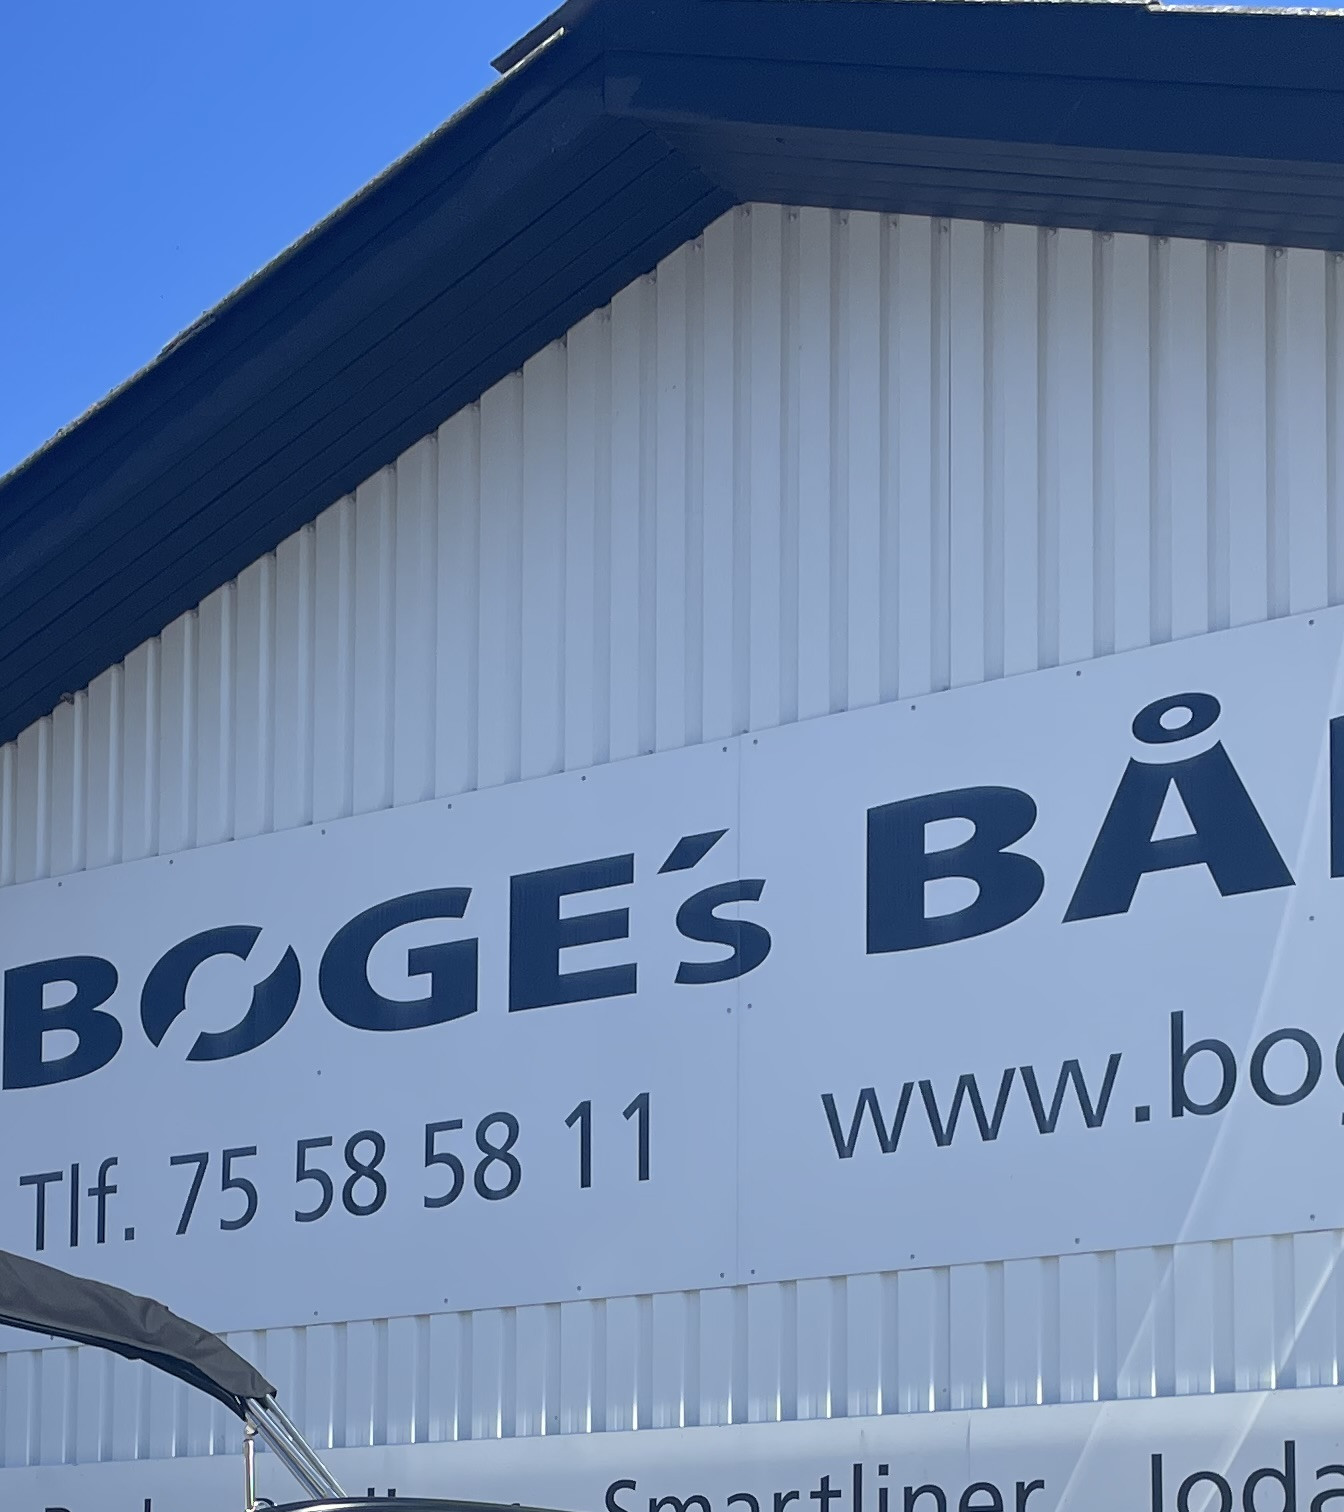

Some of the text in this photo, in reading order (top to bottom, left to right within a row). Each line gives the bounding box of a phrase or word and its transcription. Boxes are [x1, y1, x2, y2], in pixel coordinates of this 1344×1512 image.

[19, 1092, 652, 1251] Tlf. 75 58 58 11
